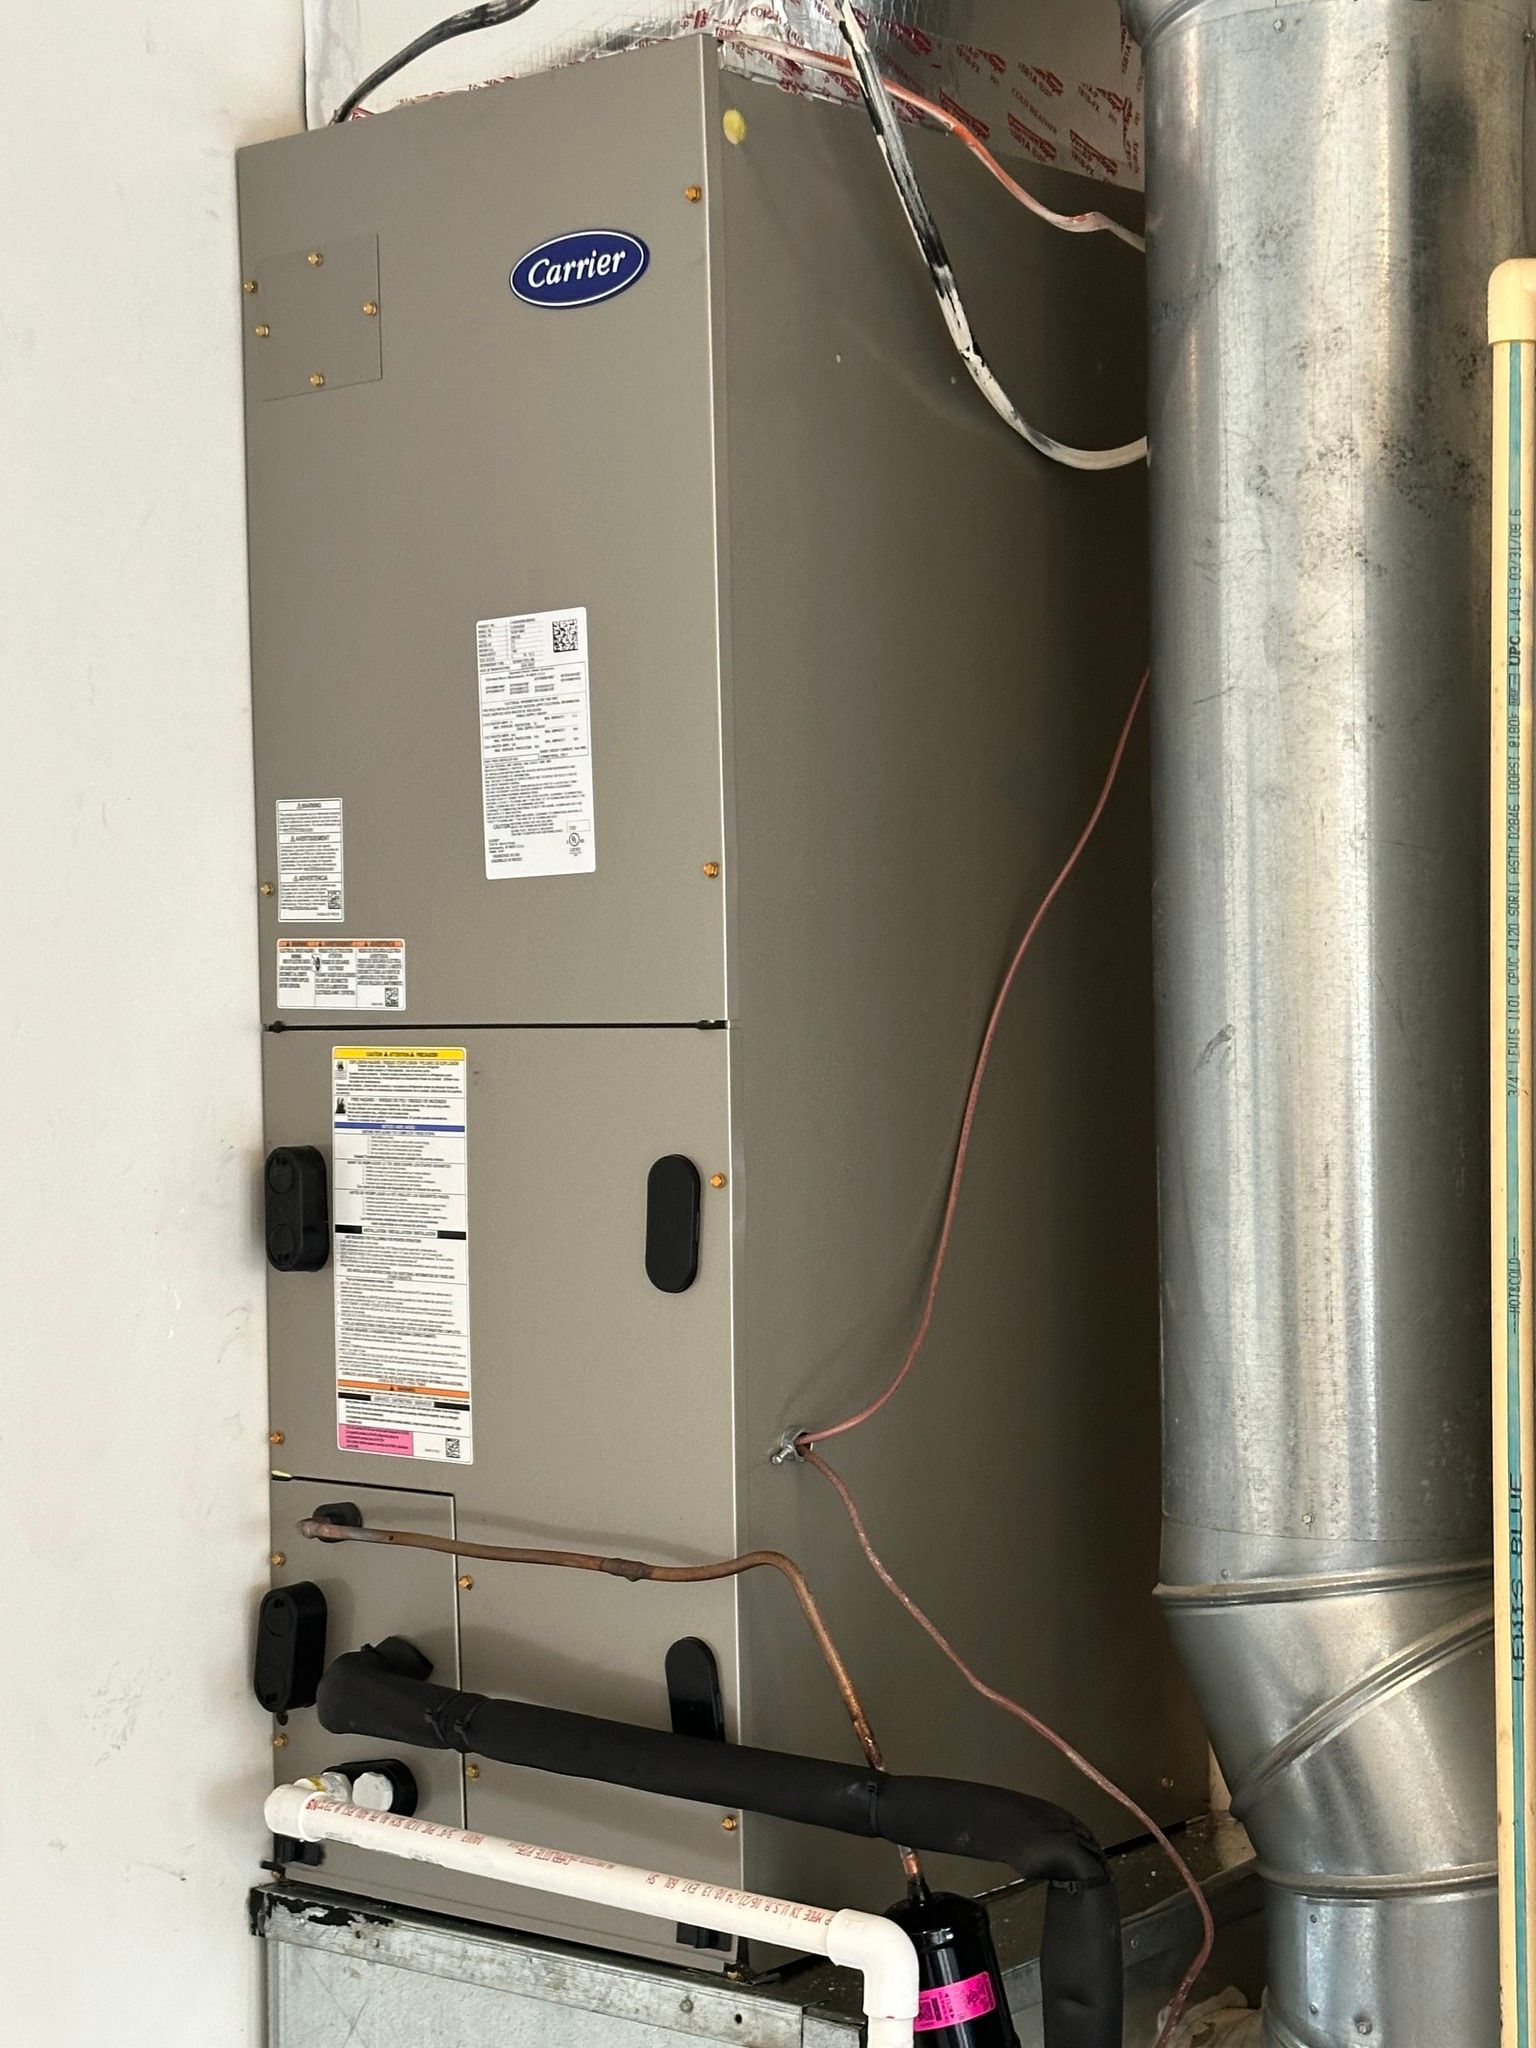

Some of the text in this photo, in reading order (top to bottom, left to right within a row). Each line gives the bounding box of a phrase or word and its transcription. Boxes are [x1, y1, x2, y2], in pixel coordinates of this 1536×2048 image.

[528, 249, 626, 288] Carrier
[1508, 757, 1520, 795] 100PSI
[1508, 804, 1520, 841] D2846
[1508, 846, 1520, 875] ASTM
[1508, 881, 1520, 917] SDR11
[1508, 923, 1520, 951] 4120
[1507, 957, 1520, 986] CPVC
[1511, 1577, 1525, 1682] LEWIS
